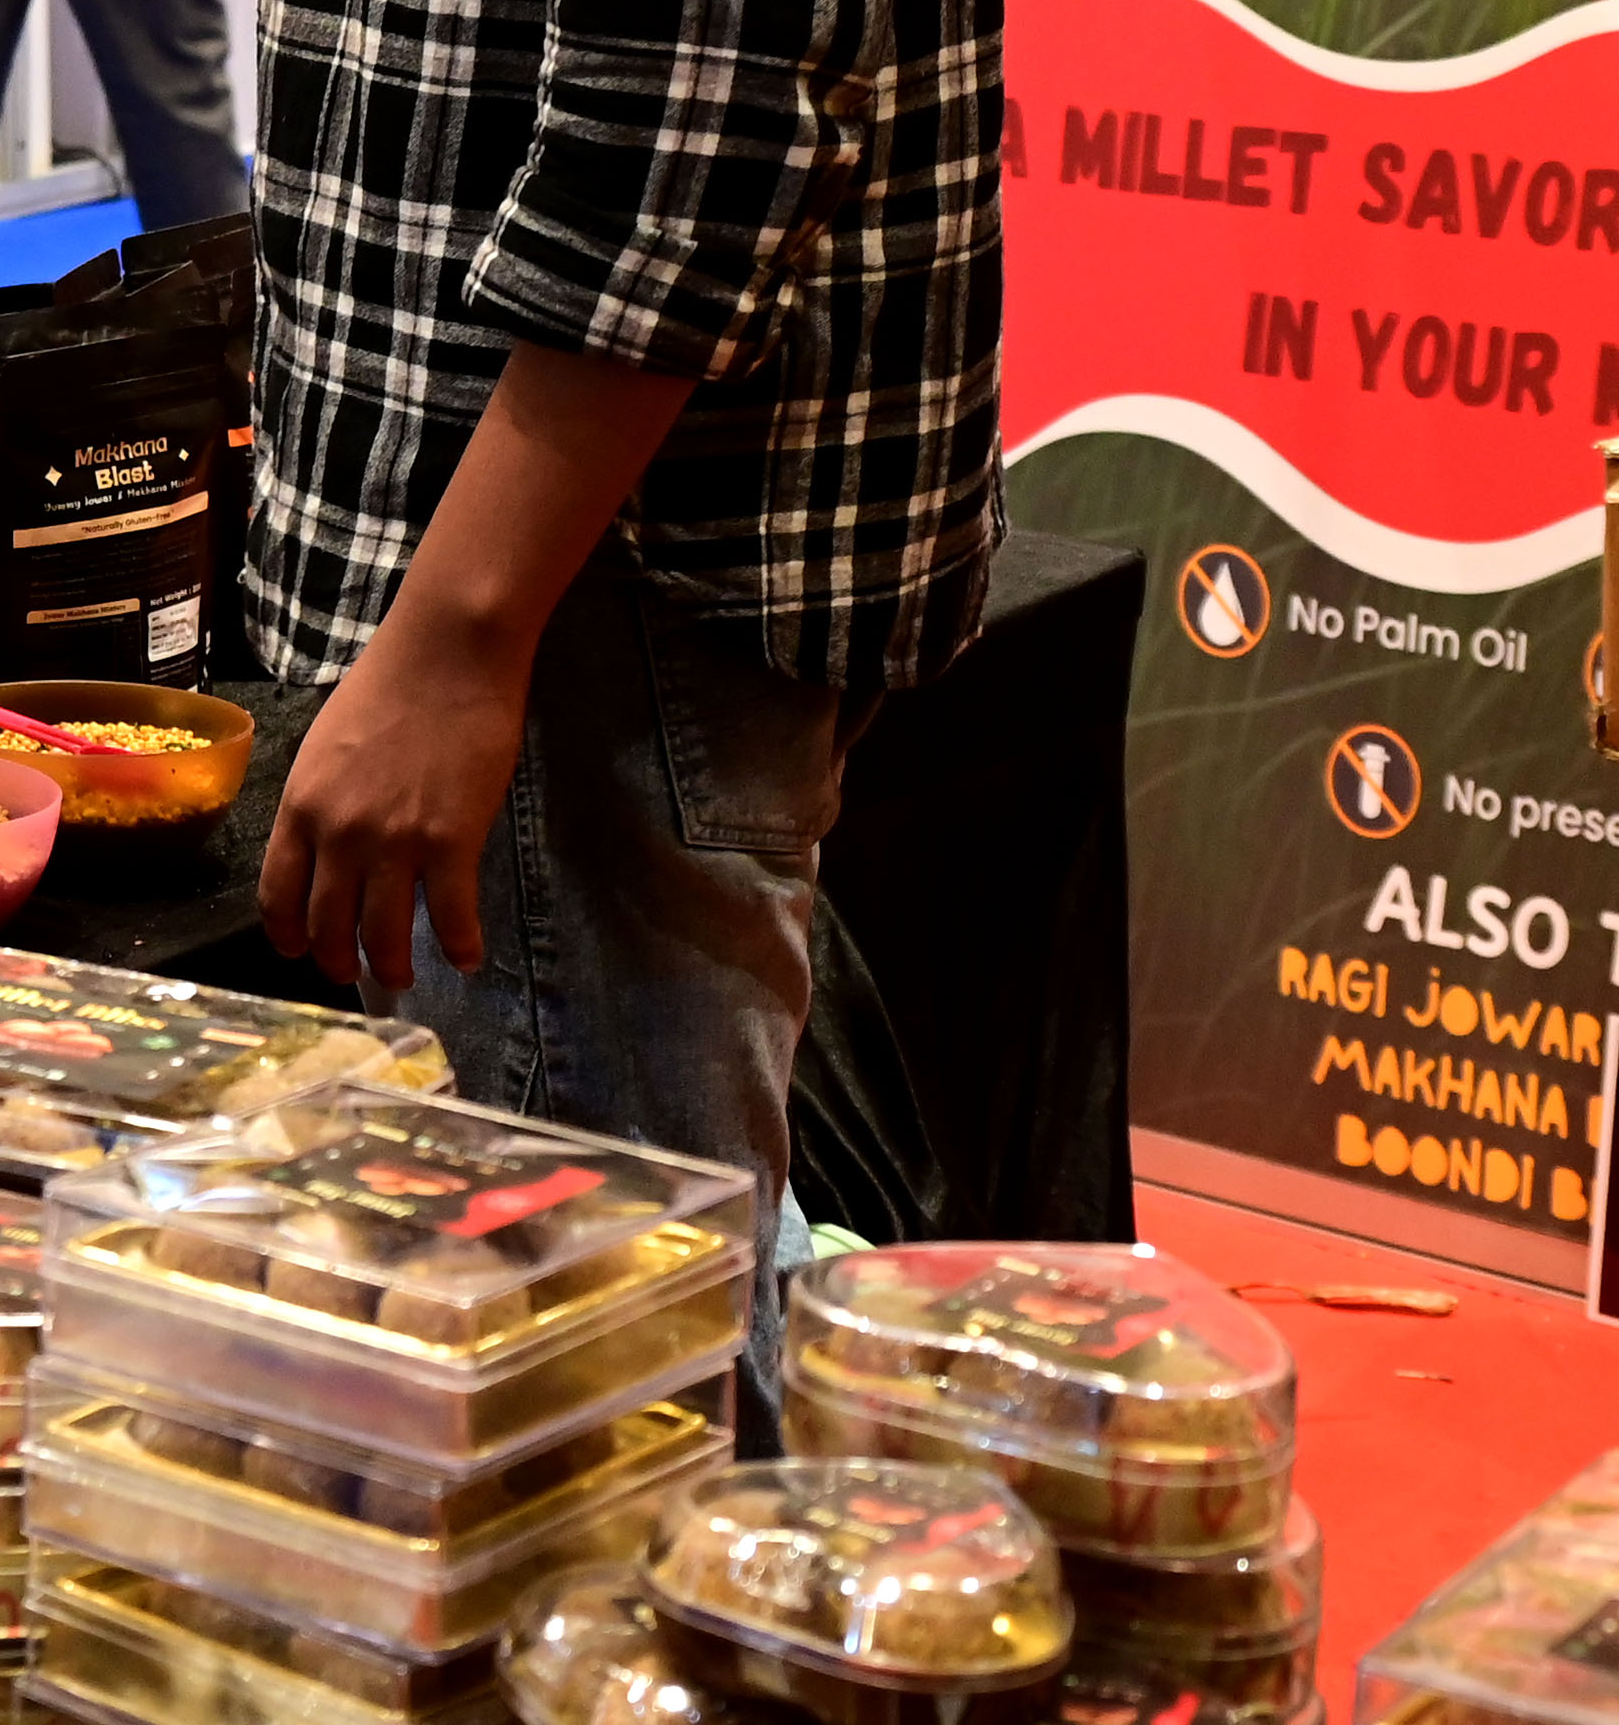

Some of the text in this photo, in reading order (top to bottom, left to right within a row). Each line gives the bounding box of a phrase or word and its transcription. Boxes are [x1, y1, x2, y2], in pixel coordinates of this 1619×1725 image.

[1060, 104, 1329, 215] MILLET
[1358, 141, 1619, 254] SAVOR
[1242, 291, 1318, 382] IN
[1351, 307, 1560, 416] YOUR
[74, 437, 169, 468] Makhana
[95, 460, 155, 490] Blast
[1286, 593, 1529, 675] No Palm Oil
[1443, 772, 1502, 821] No
[1364, 863, 1570, 970] ALSO
[1278, 946, 1390, 1019] RAGI
[1312, 1034, 1569, 1140] MAKHANA
[1334, 1113, 1535, 1211] BOONDI
